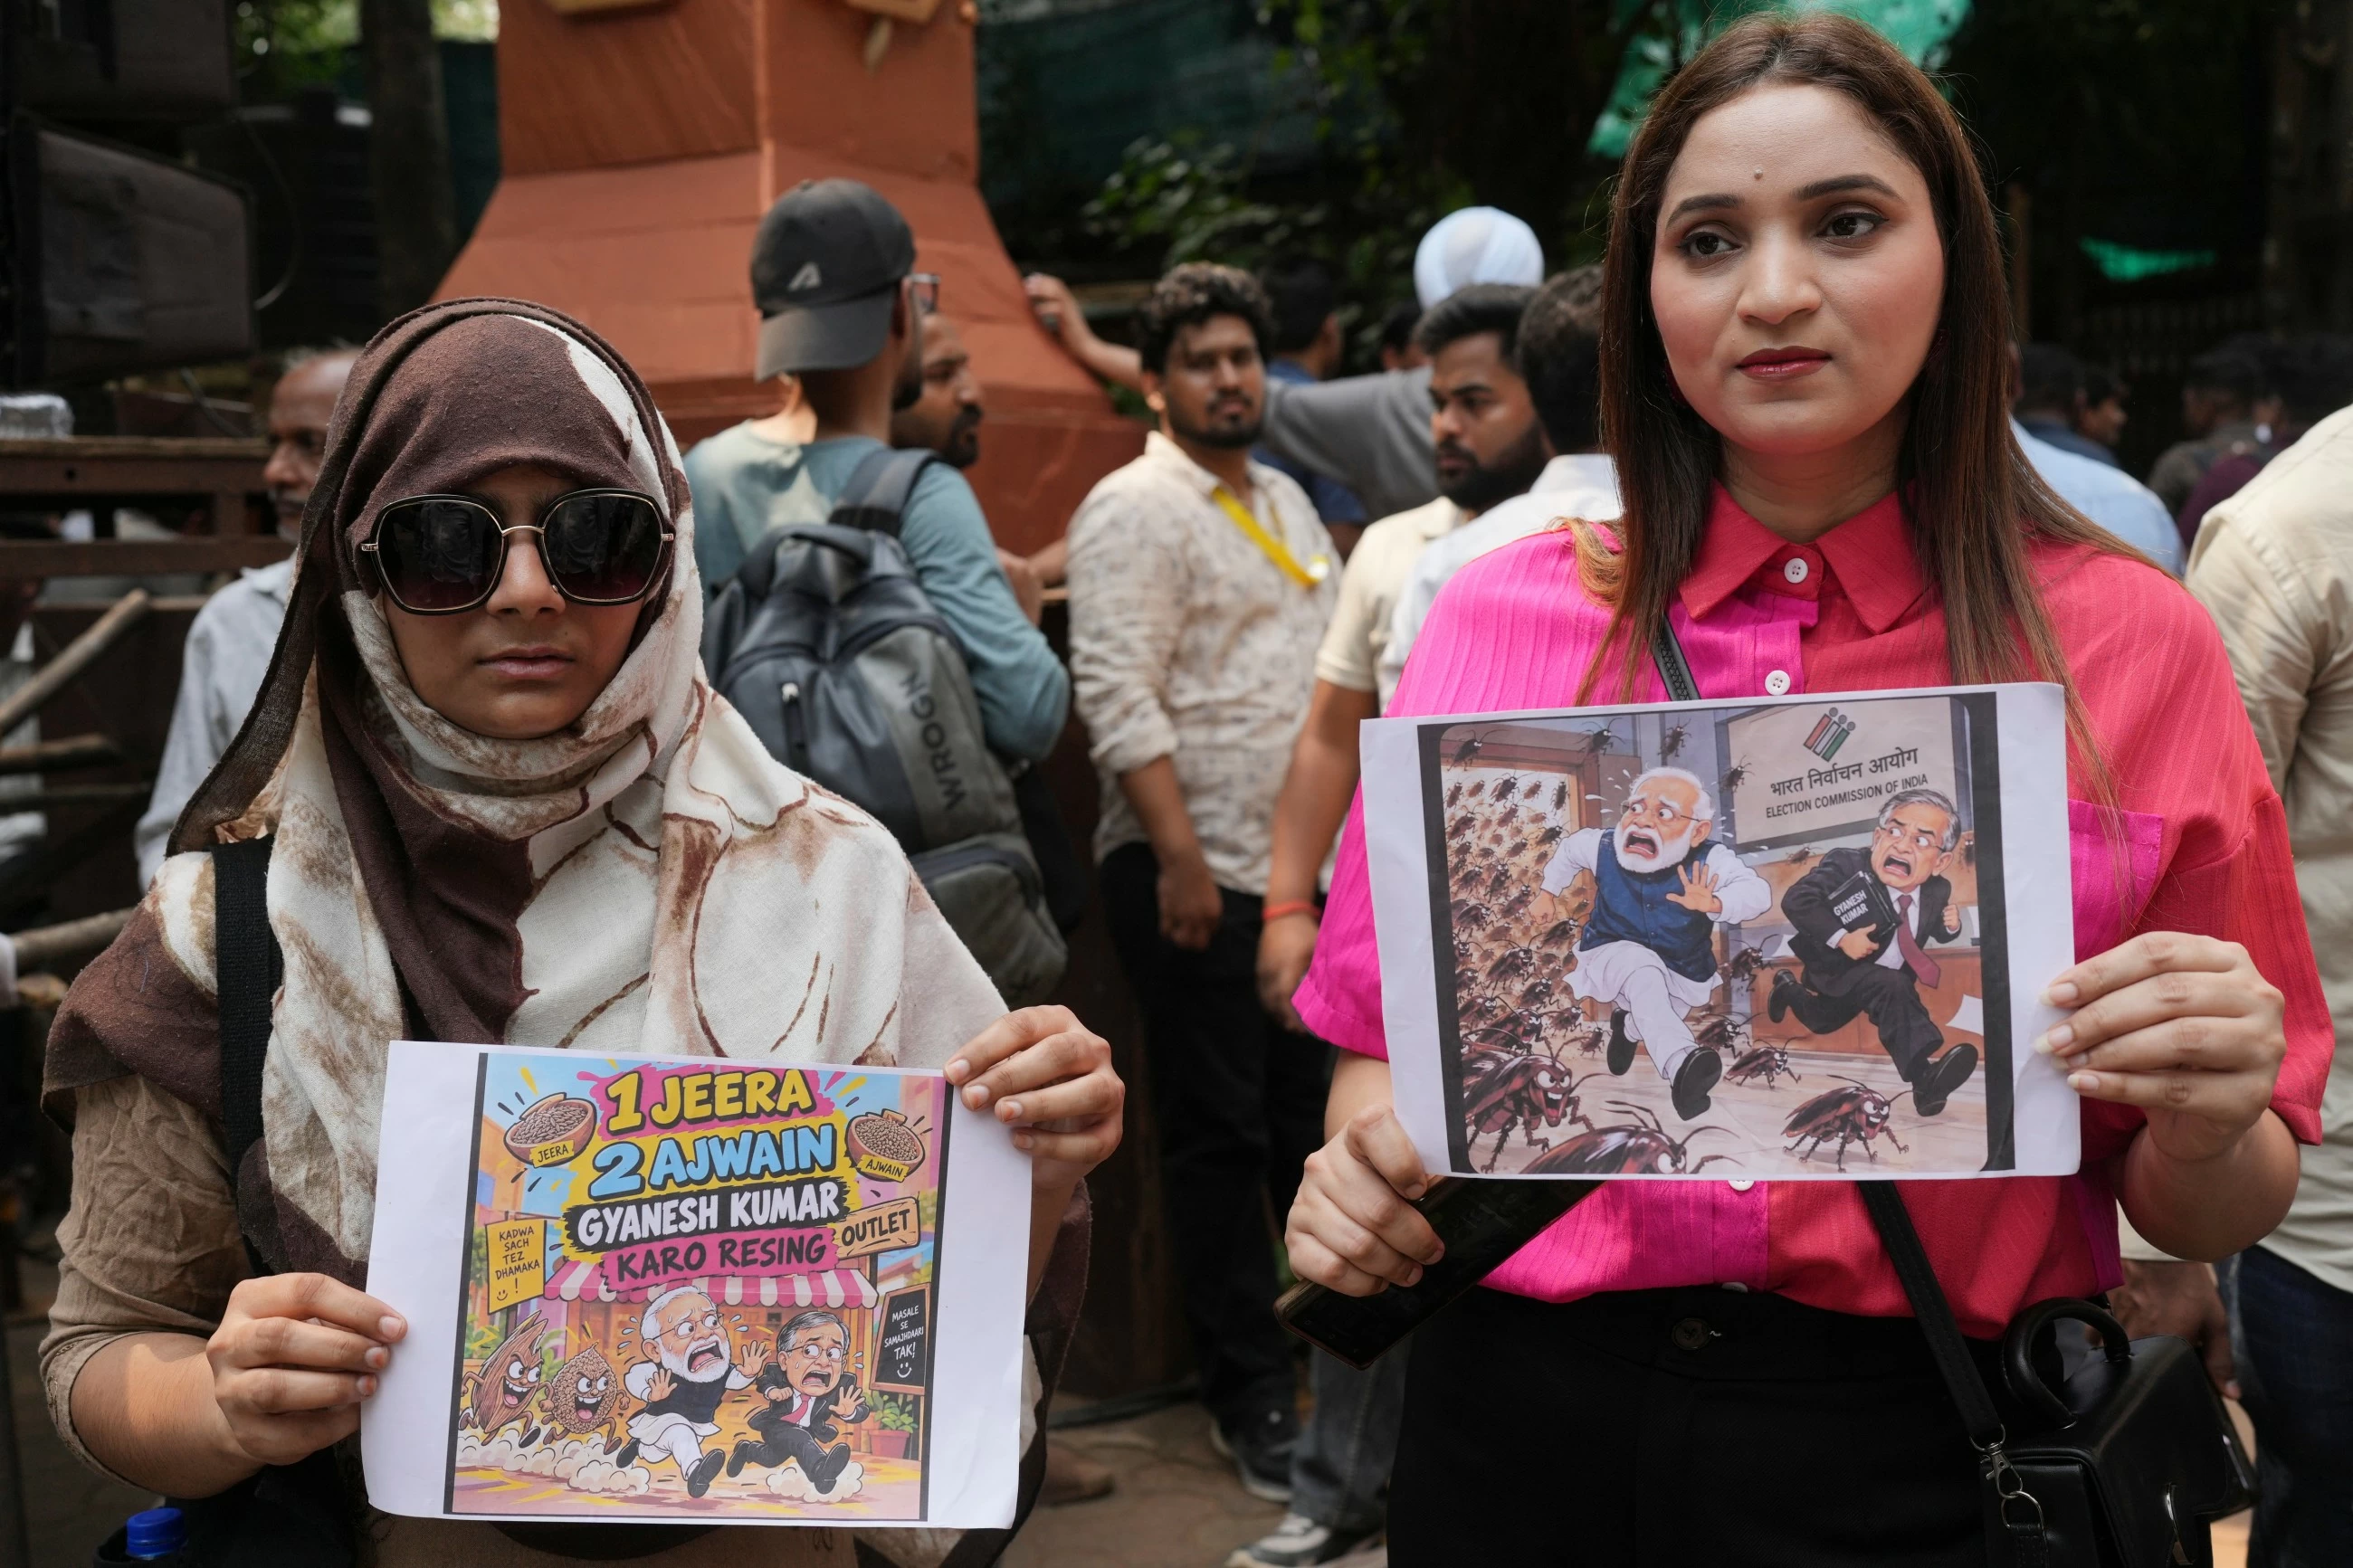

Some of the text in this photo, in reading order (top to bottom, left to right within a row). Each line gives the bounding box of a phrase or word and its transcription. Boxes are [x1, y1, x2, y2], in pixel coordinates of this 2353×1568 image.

[1770, 746, 1919, 796] भारत निर्वाचन आयोग
[1766, 774, 1929, 818] ELECTION COMMISSION OF INDIA
[1834, 889, 1867, 916] GYANESH
[1840, 903, 1869, 925] KUMAR
[606, 1069, 814, 1133] 1 JEERA
[538, 1144, 569, 1163] JEERA
[589, 1125, 834, 1199] 2 AJWAIN
[865, 1159, 904, 1177] AJWAIN
[577, 1181, 841, 1246] GYANESH KUMAR
[499, 1226, 534, 1241] KADWA
[842, 1209, 910, 1246] OUTLET
[504, 1238, 529, 1252] SACH
[502, 1251, 525, 1265] TEZ
[617, 1233, 827, 1282] KARO RESING
[495, 1259, 540, 1280] DHAMAKA
[891, 1305, 919, 1323] MASALE
[900, 1320, 909, 1330] SE
[884, 1326, 924, 1348] SAMAJHDAARI
[894, 1341, 916, 1361] TAK!
